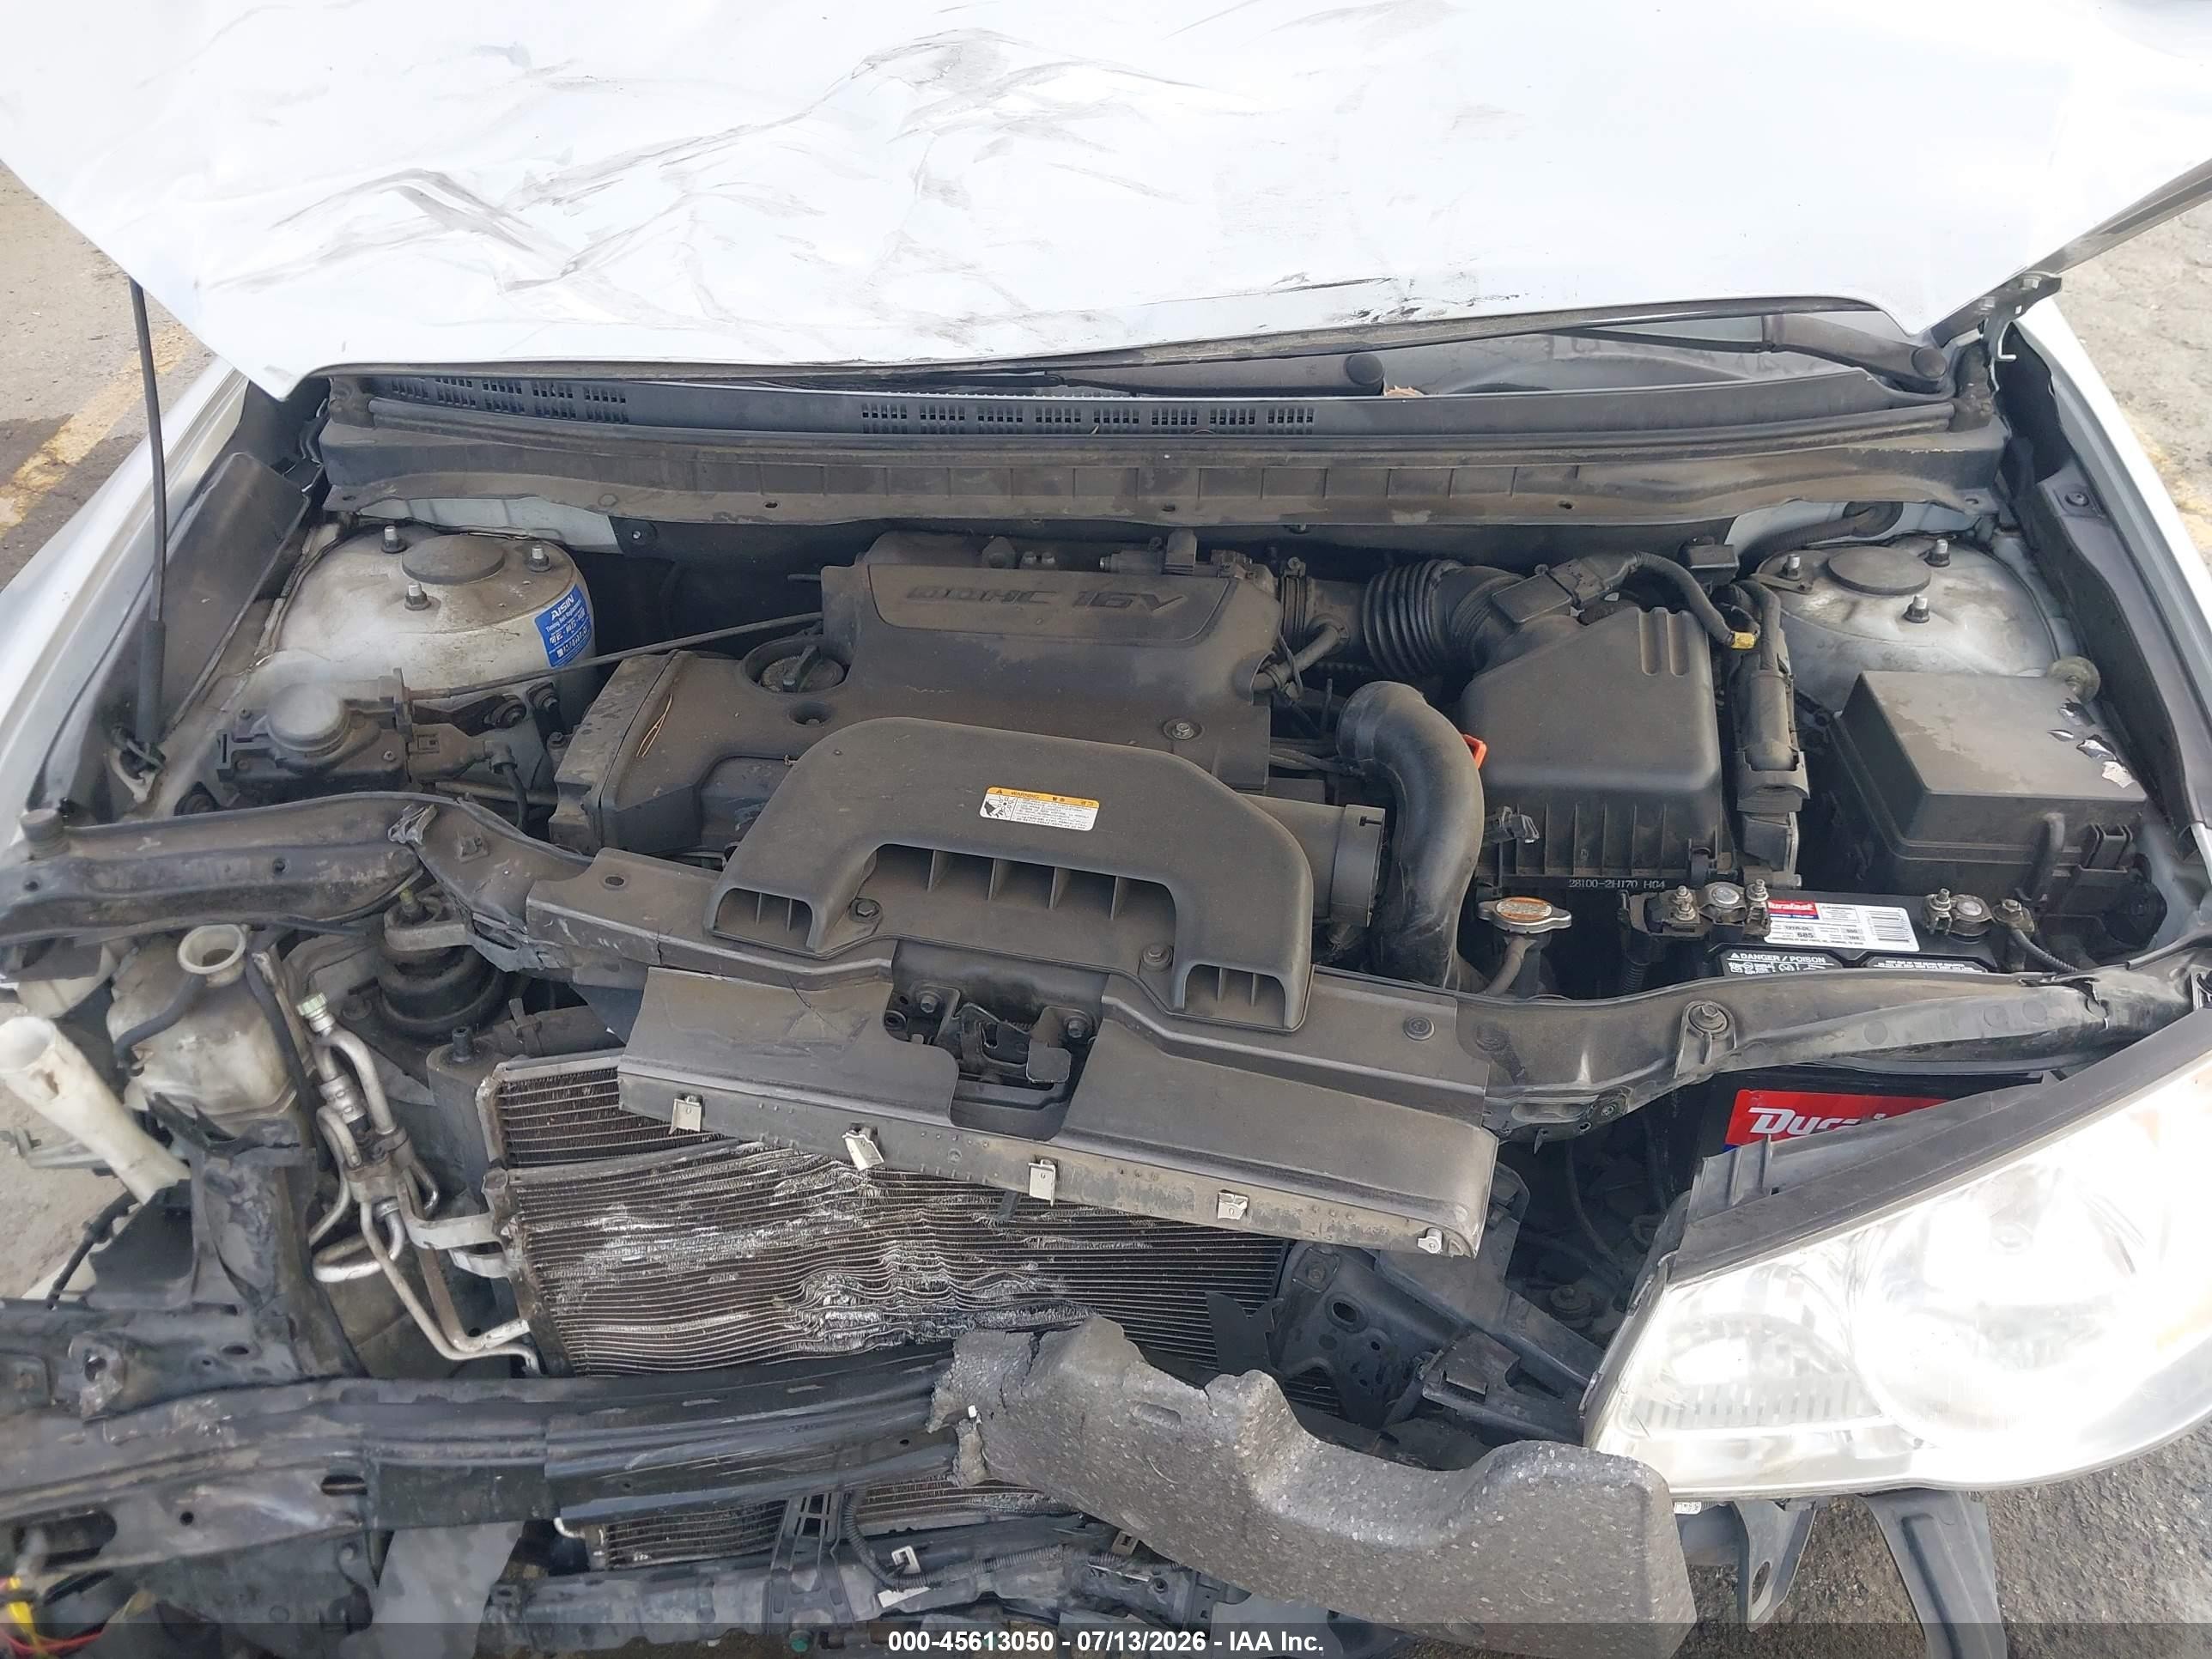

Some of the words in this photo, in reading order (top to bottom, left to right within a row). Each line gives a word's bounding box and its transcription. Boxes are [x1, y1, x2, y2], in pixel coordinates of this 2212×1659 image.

[550, 593, 574, 622] AISIN
[1073, 590, 1187, 613] 16V
[1568, 878, 1638, 889] 28100-2H170
[1740, 952, 1780, 962] DANGER
